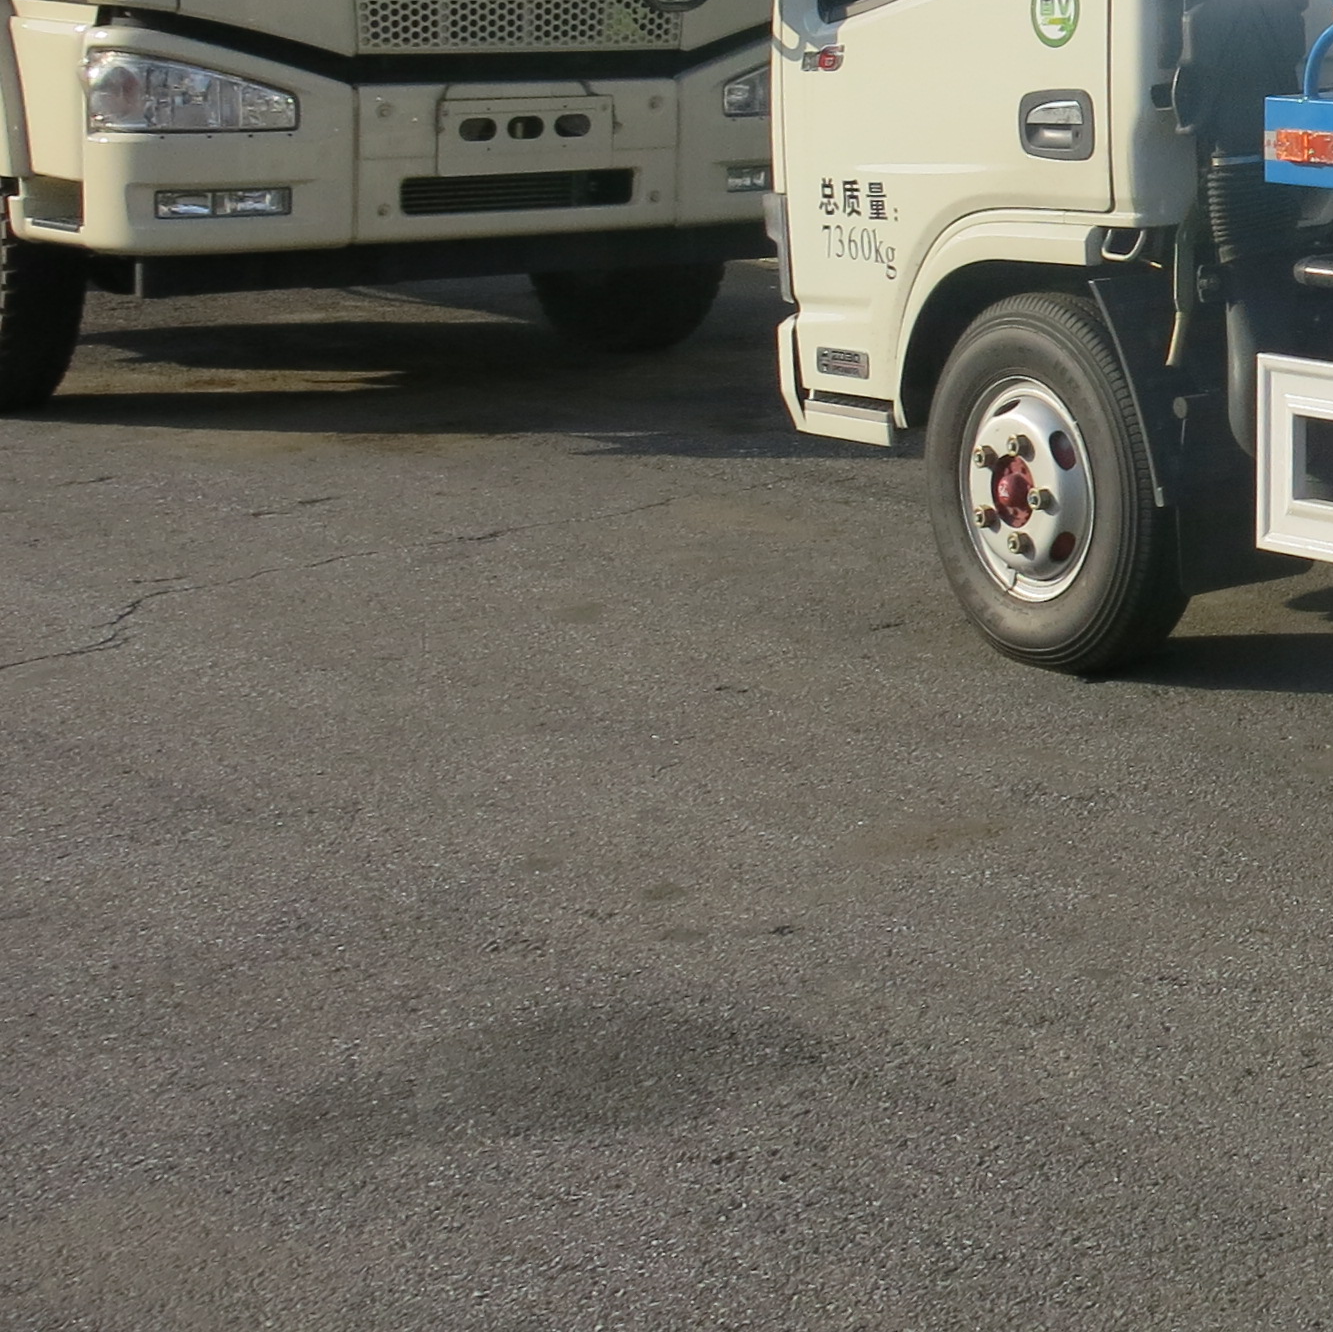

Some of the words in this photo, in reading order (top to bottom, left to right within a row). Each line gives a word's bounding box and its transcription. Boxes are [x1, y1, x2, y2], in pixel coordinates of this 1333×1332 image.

[819, 177, 898, 221] 总质量:
[822, 225, 897, 280] 7360kg
